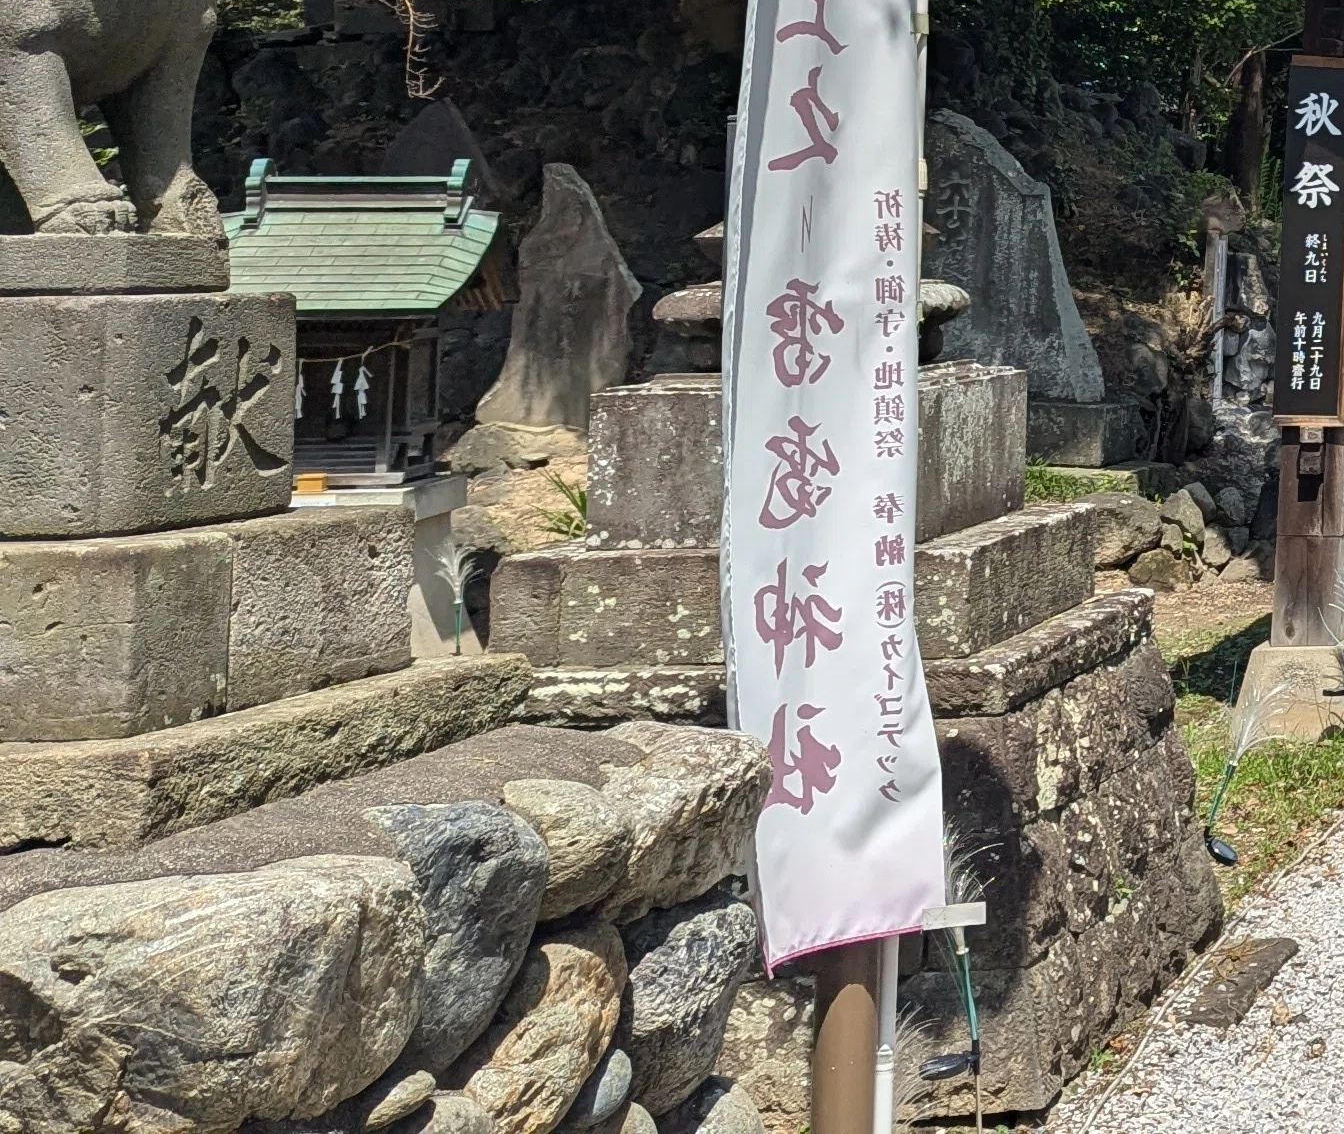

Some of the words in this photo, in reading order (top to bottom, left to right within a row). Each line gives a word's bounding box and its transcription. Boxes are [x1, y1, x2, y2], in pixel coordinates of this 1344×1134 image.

[1289, 92, 1343, 209] 秋祭
[1309, 311, 1326, 391] 九月二十九日
